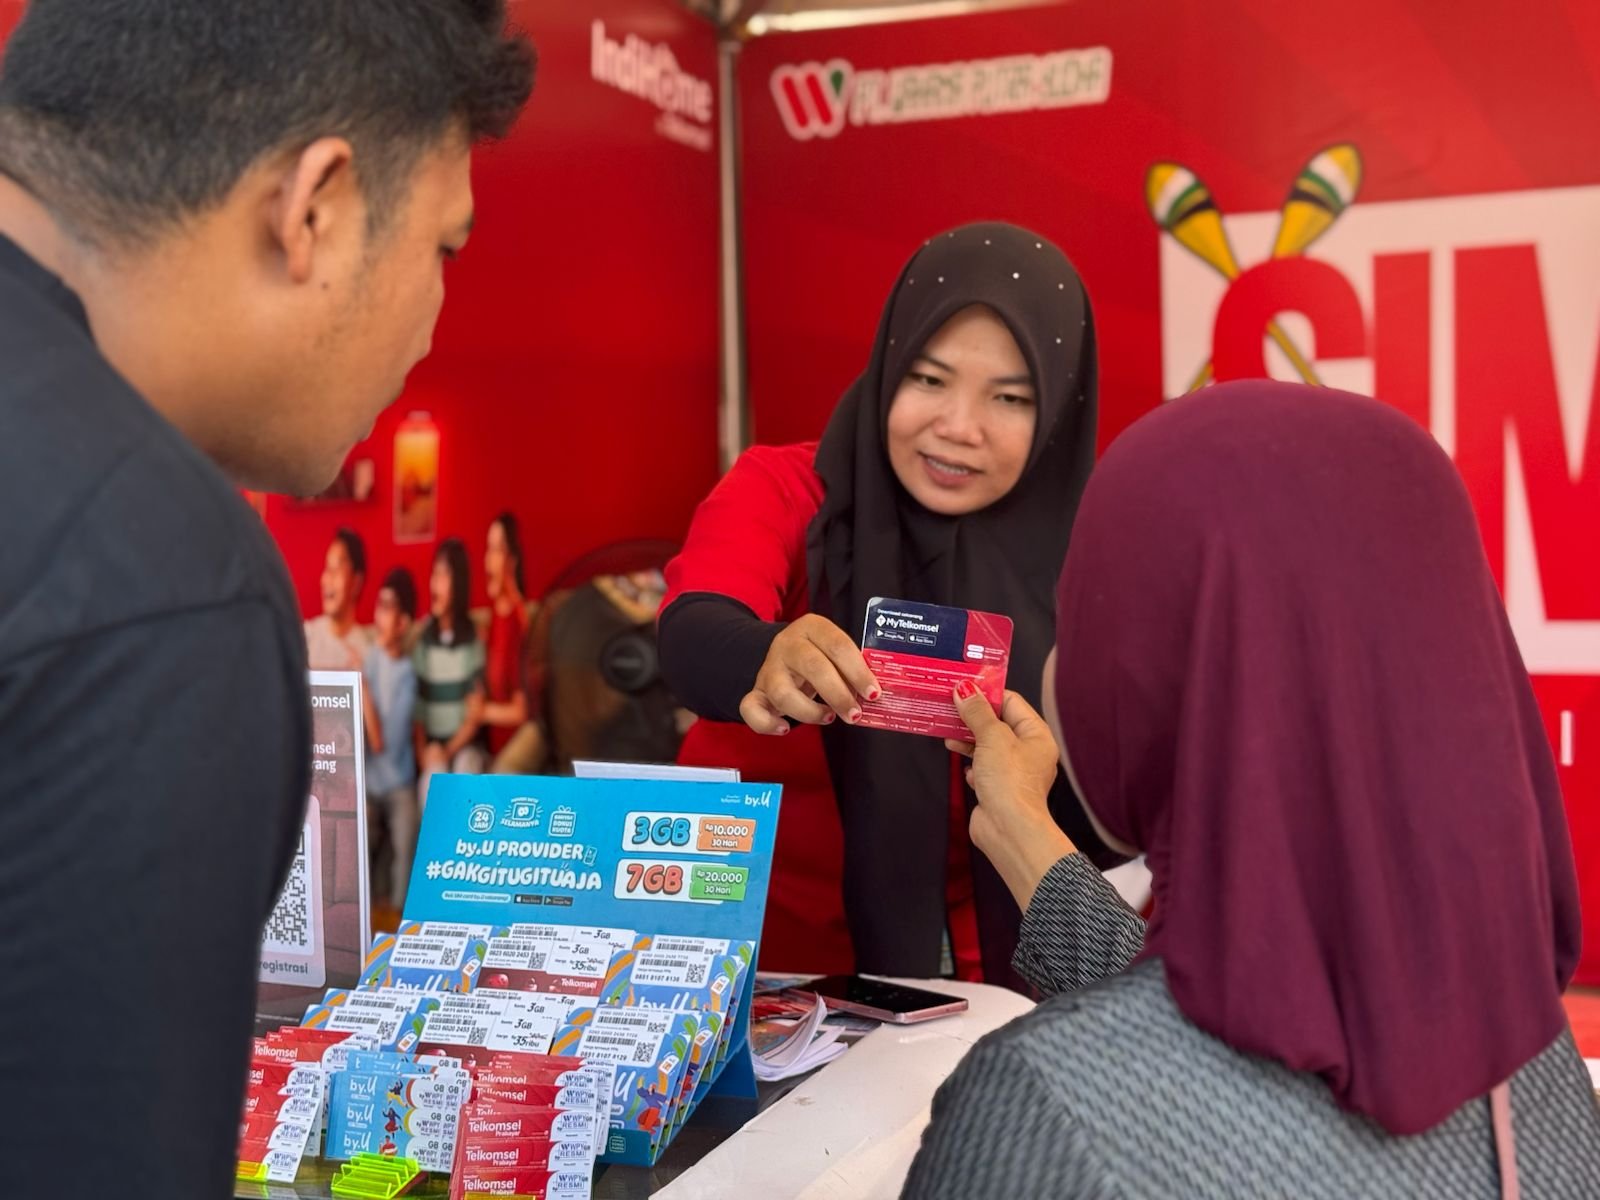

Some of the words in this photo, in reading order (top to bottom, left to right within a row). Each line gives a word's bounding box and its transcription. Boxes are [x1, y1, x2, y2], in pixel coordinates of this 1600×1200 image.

[886, 617, 939, 632] MyTelkomsel
[744, 790, 772, 808] by.U
[474, 811, 489, 821] 24
[473, 821, 488, 829] JAM
[632, 816, 691, 846] 3GB
[456, 838, 495, 858] by.U
[497, 841, 584, 860] PROVIDER
[711, 838, 721, 847] 30
[722, 839, 738, 848] Hari
[626, 863, 683, 895] 7GB
[704, 885, 715, 894] 30
[716, 886, 731, 895] Hari
[561, 978, 597, 989] Telkomsel
[255, 1044, 298, 1058] Telkomsel
[350, 1075, 377, 1096] by.U
[477, 1073, 527, 1085] Telkomsel
[347, 1103, 374, 1124] by.U
[431, 1112, 442, 1121] GB
[445, 1114, 456, 1122] GB
[468, 1120, 521, 1132] Telkomsel
[344, 1131, 371, 1152] by.U
[428, 1140, 439, 1149] GB
[442, 1142, 453, 1151] GB
[466, 1148, 519, 1162] Telkomsel
[463, 1178, 516, 1191] Telkomsel
